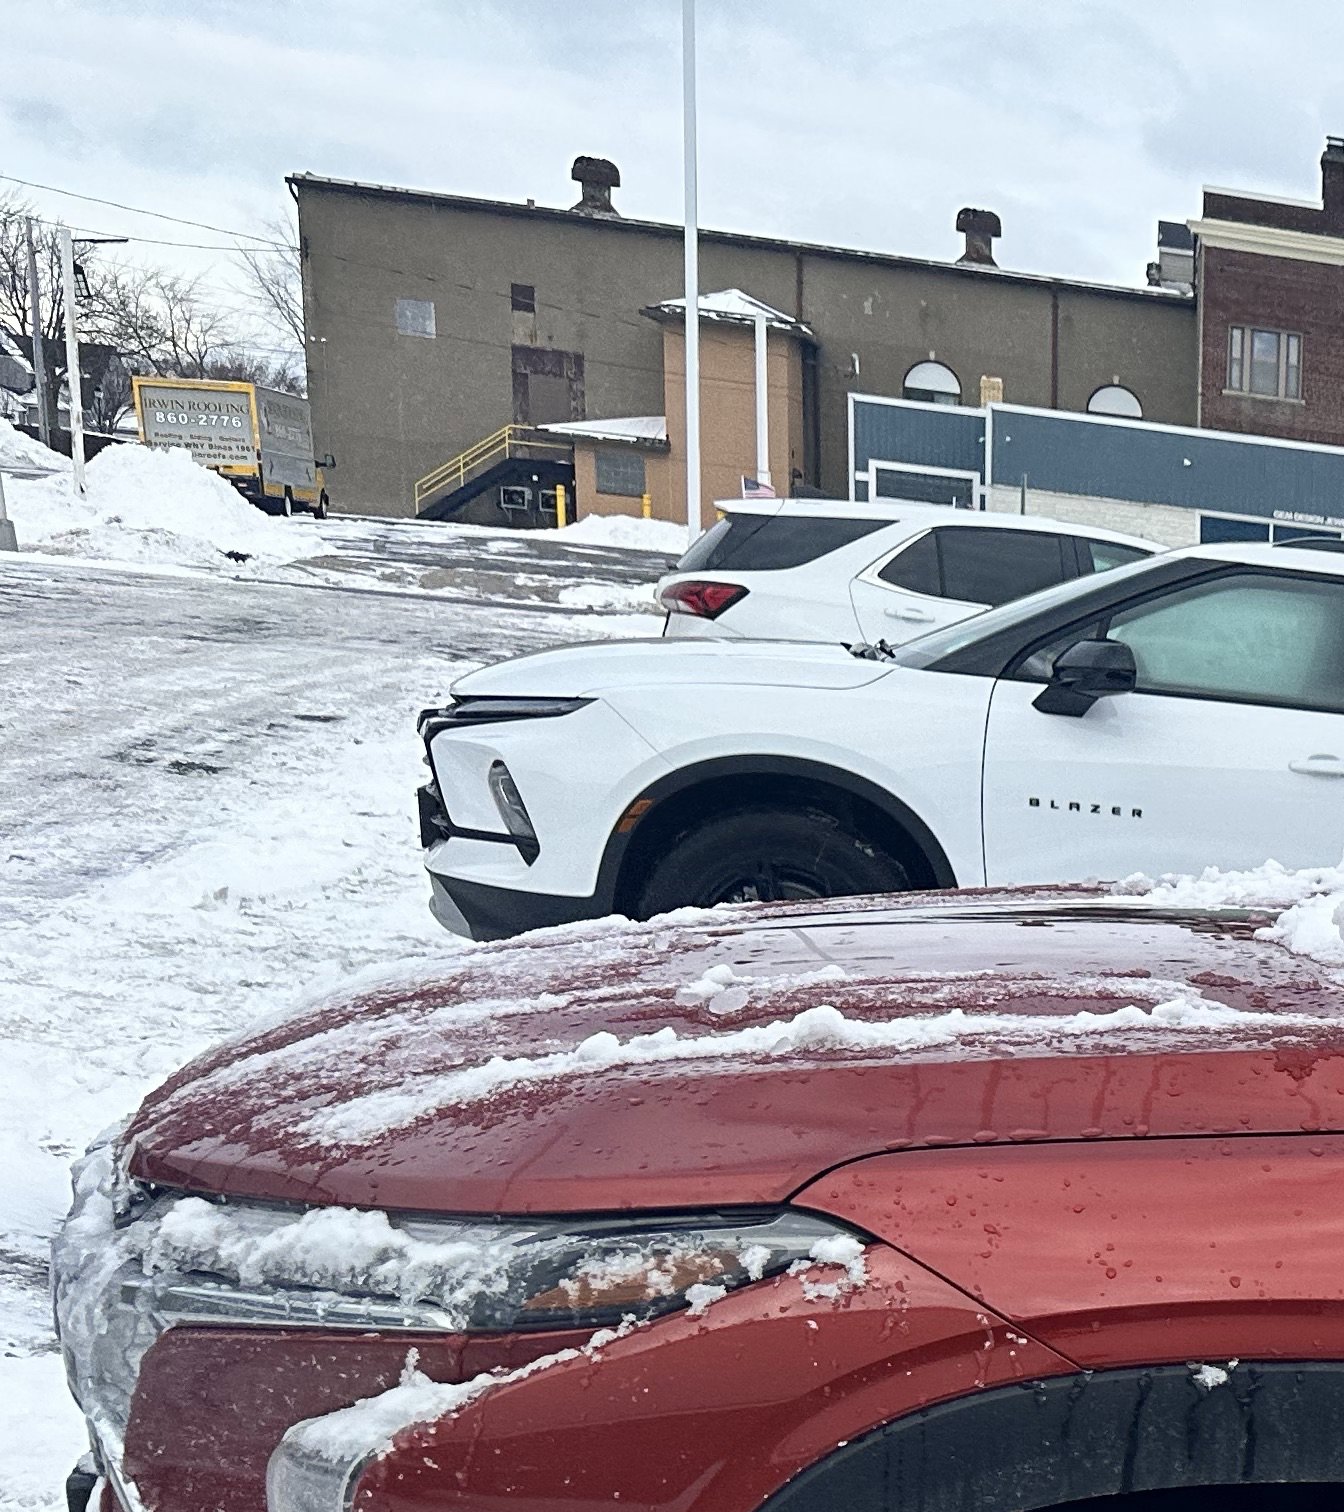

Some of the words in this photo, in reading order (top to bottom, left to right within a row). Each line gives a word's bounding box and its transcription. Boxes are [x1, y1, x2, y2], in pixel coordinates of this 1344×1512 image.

[144, 397, 185, 411] IRWIN
[155, 411, 242, 428] 860-2776
[1029, 797, 1142, 818] BLAZER
